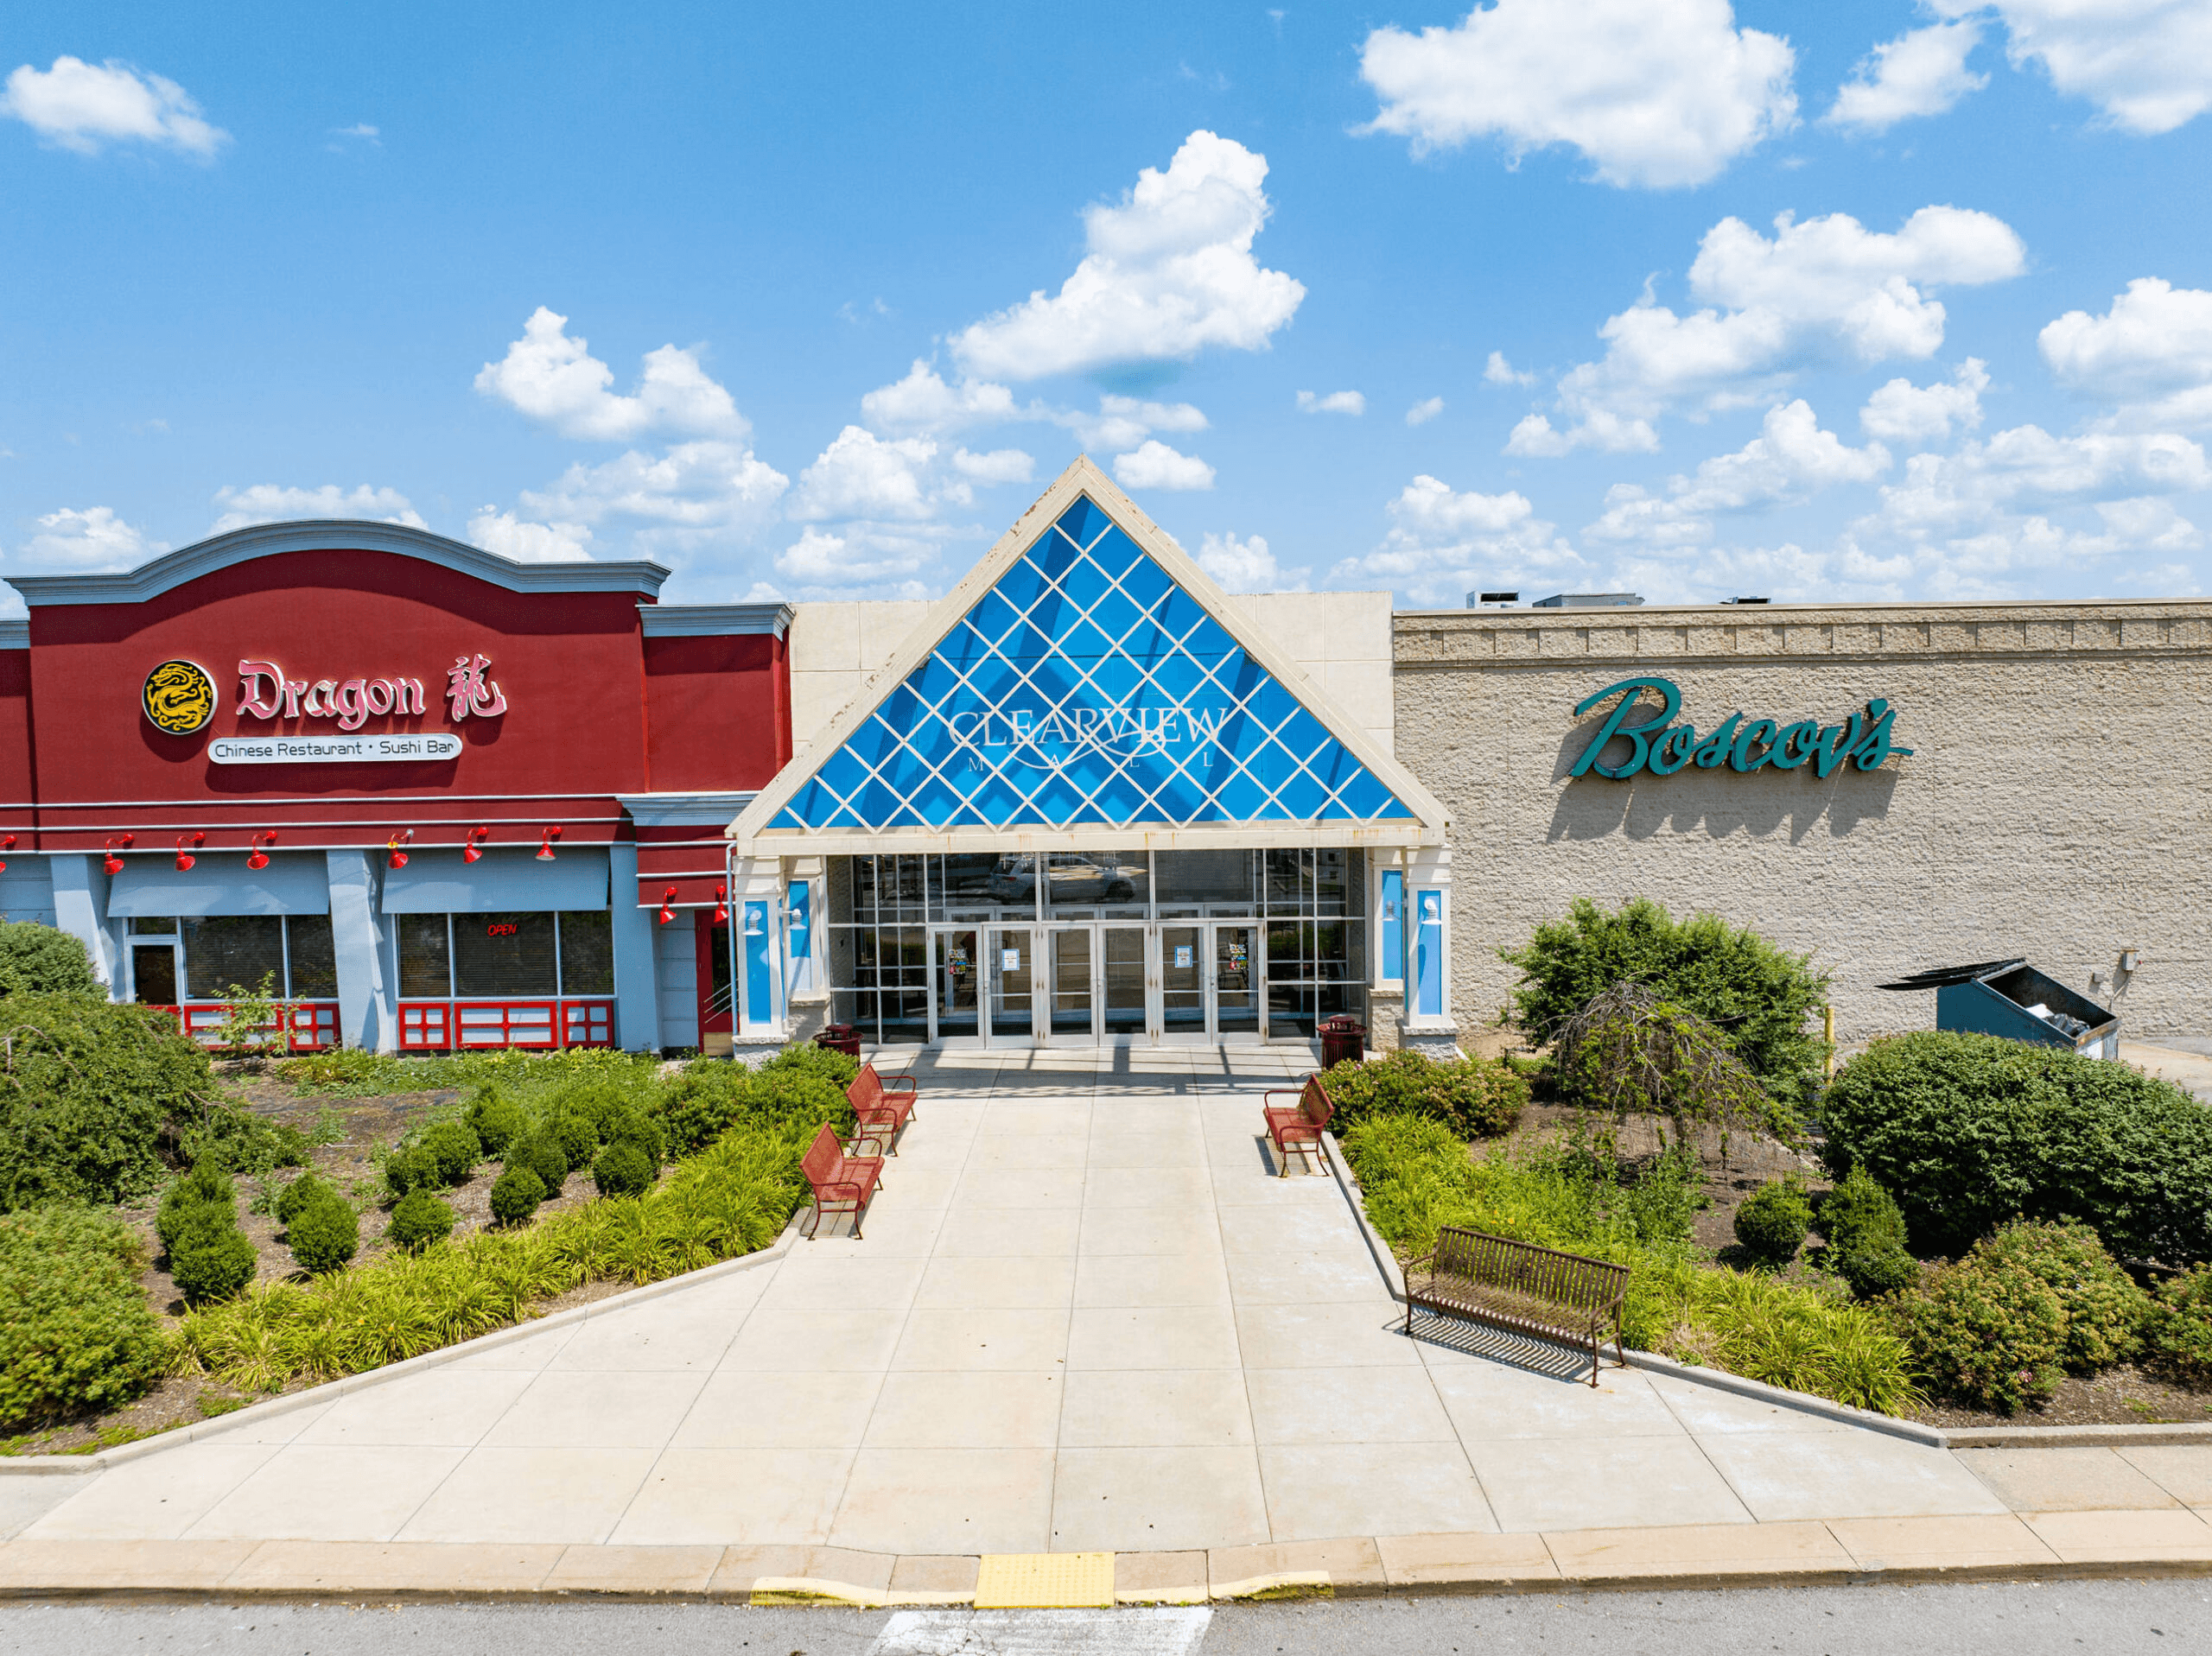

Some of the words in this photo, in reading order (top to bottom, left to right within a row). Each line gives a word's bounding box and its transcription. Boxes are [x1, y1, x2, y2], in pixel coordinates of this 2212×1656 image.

[236, 659, 427, 731] Dragon
[447, 653, 508, 722] 龍
[214, 745, 273, 758] Chinese
[277, 742, 363, 757] Restaurant
[379, 739, 422, 754] Sushi
[427, 740, 454, 753] Bar
[949, 707, 1229, 747] CLEARVIEW
[1568, 676, 1914, 778] Boscov's
[487, 923, 518, 936] OPEN
